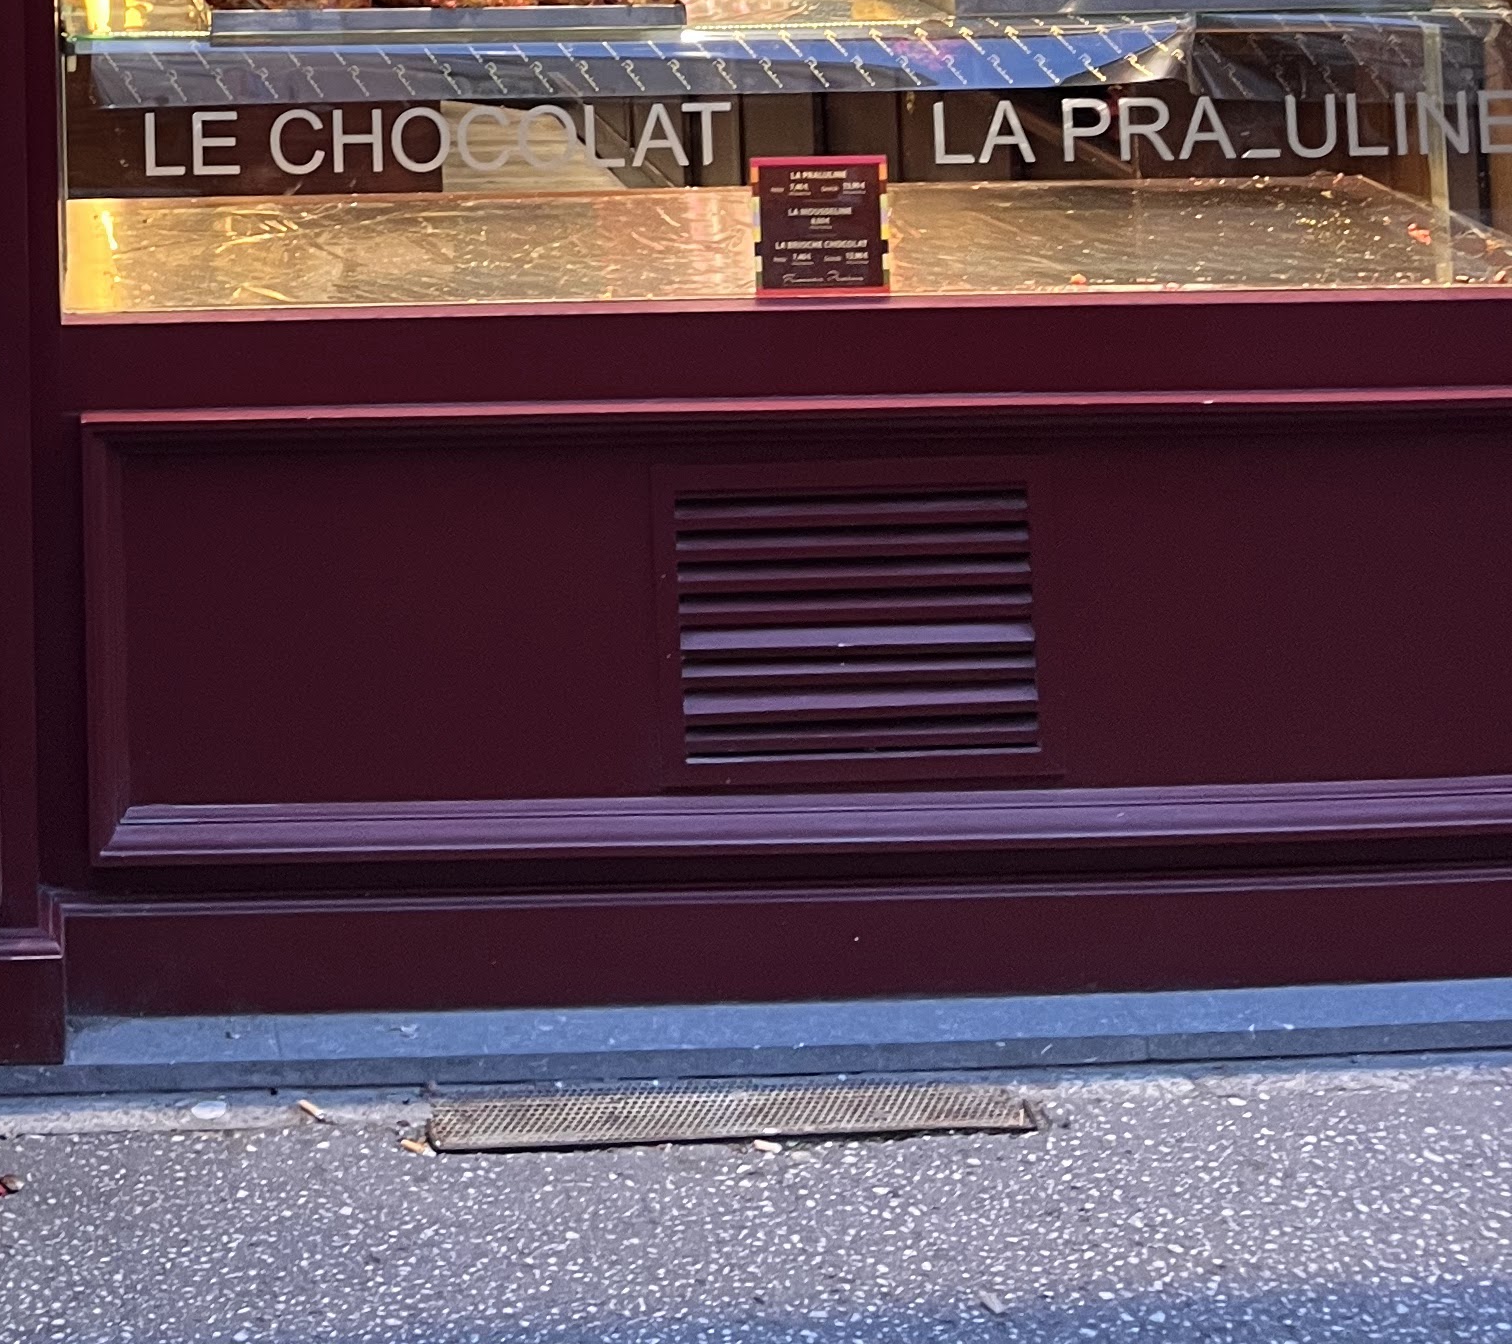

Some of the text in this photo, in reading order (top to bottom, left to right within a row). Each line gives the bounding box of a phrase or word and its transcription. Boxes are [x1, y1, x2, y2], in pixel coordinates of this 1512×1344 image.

[144, 102, 732, 177] LE CHOCOLAT
[932, 99, 1037, 165] LA
